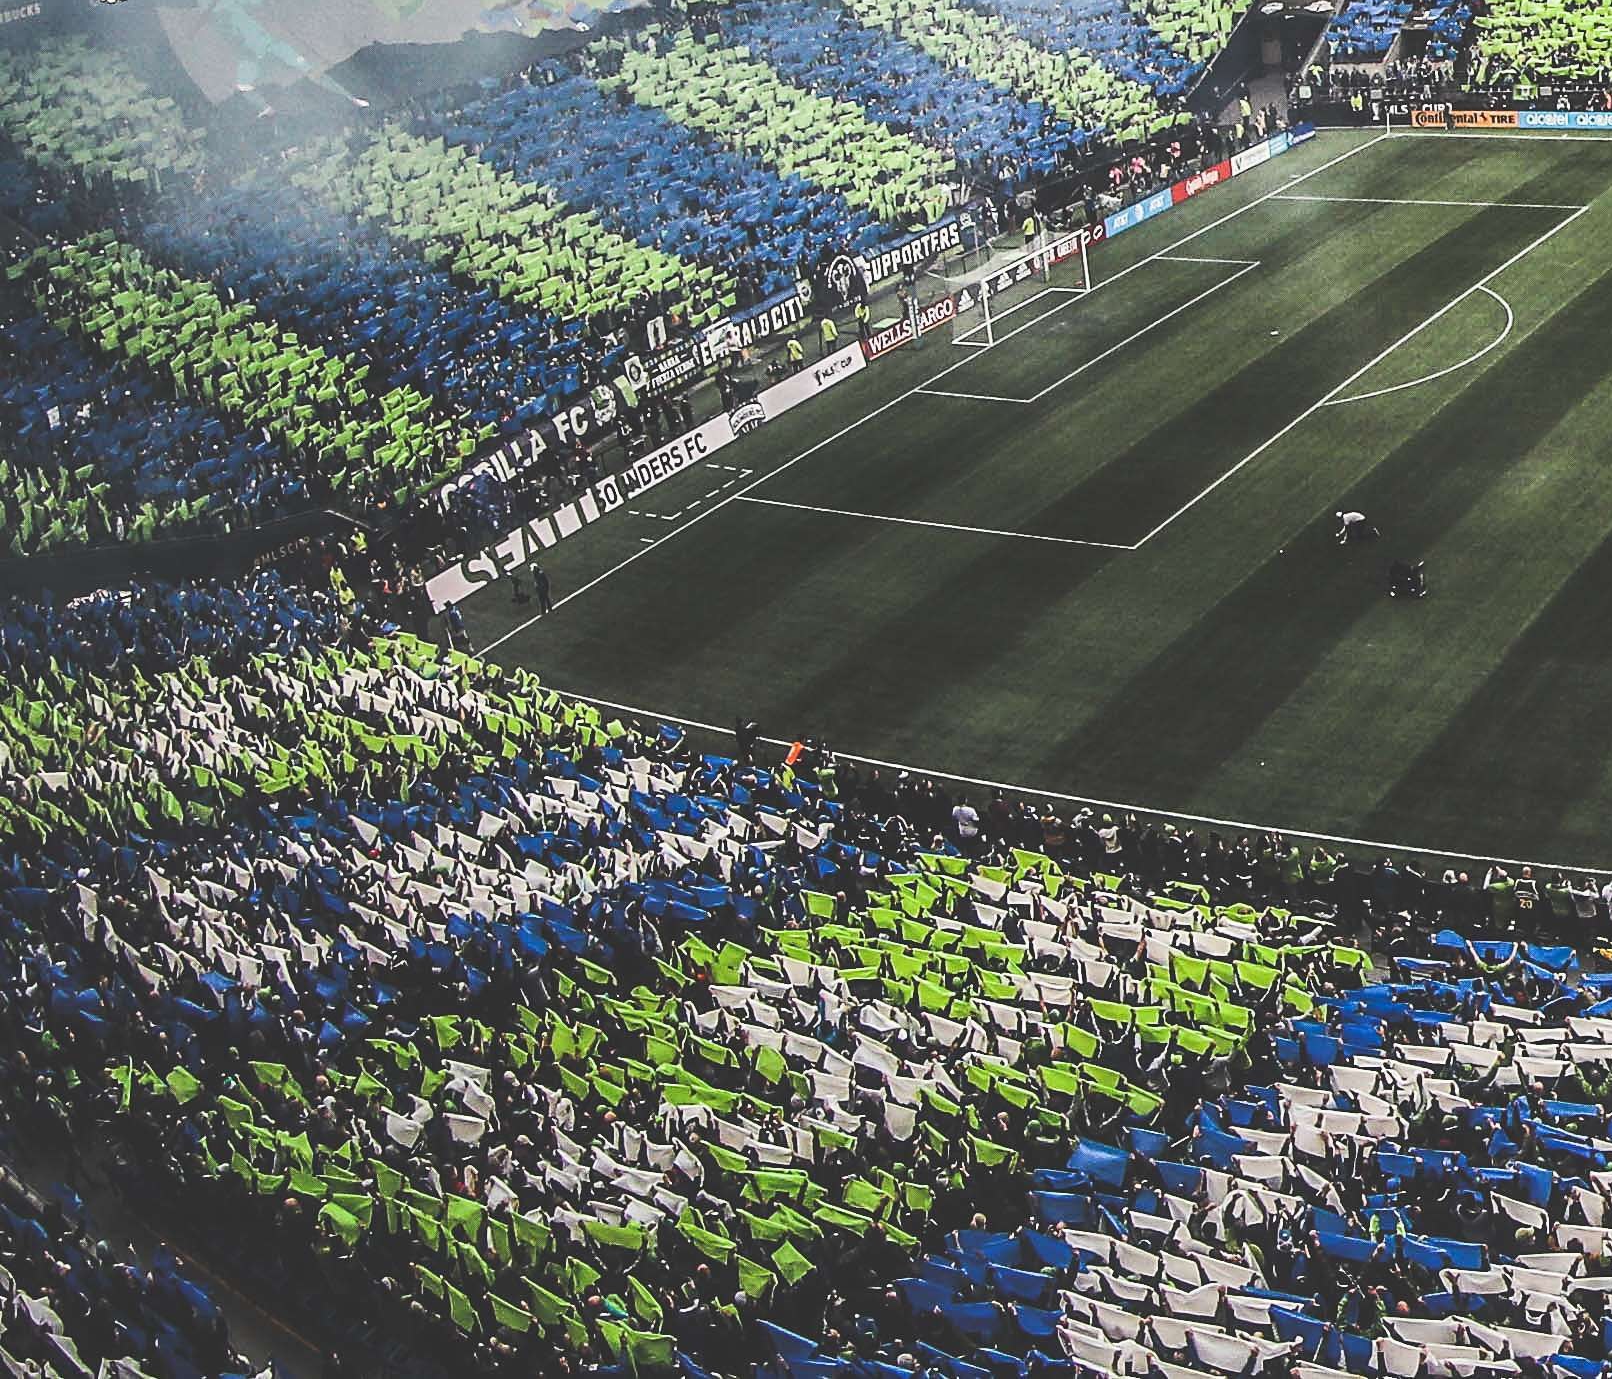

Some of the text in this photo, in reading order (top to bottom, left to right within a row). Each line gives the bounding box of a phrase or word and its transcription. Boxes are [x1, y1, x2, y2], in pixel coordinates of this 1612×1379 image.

[1490, 115, 1515, 124] TIRE
[771, 296, 804, 332] CITY
[868, 321, 912, 355] WELLS
[552, 406, 588, 443] FC
[686, 432, 707, 462] FC
